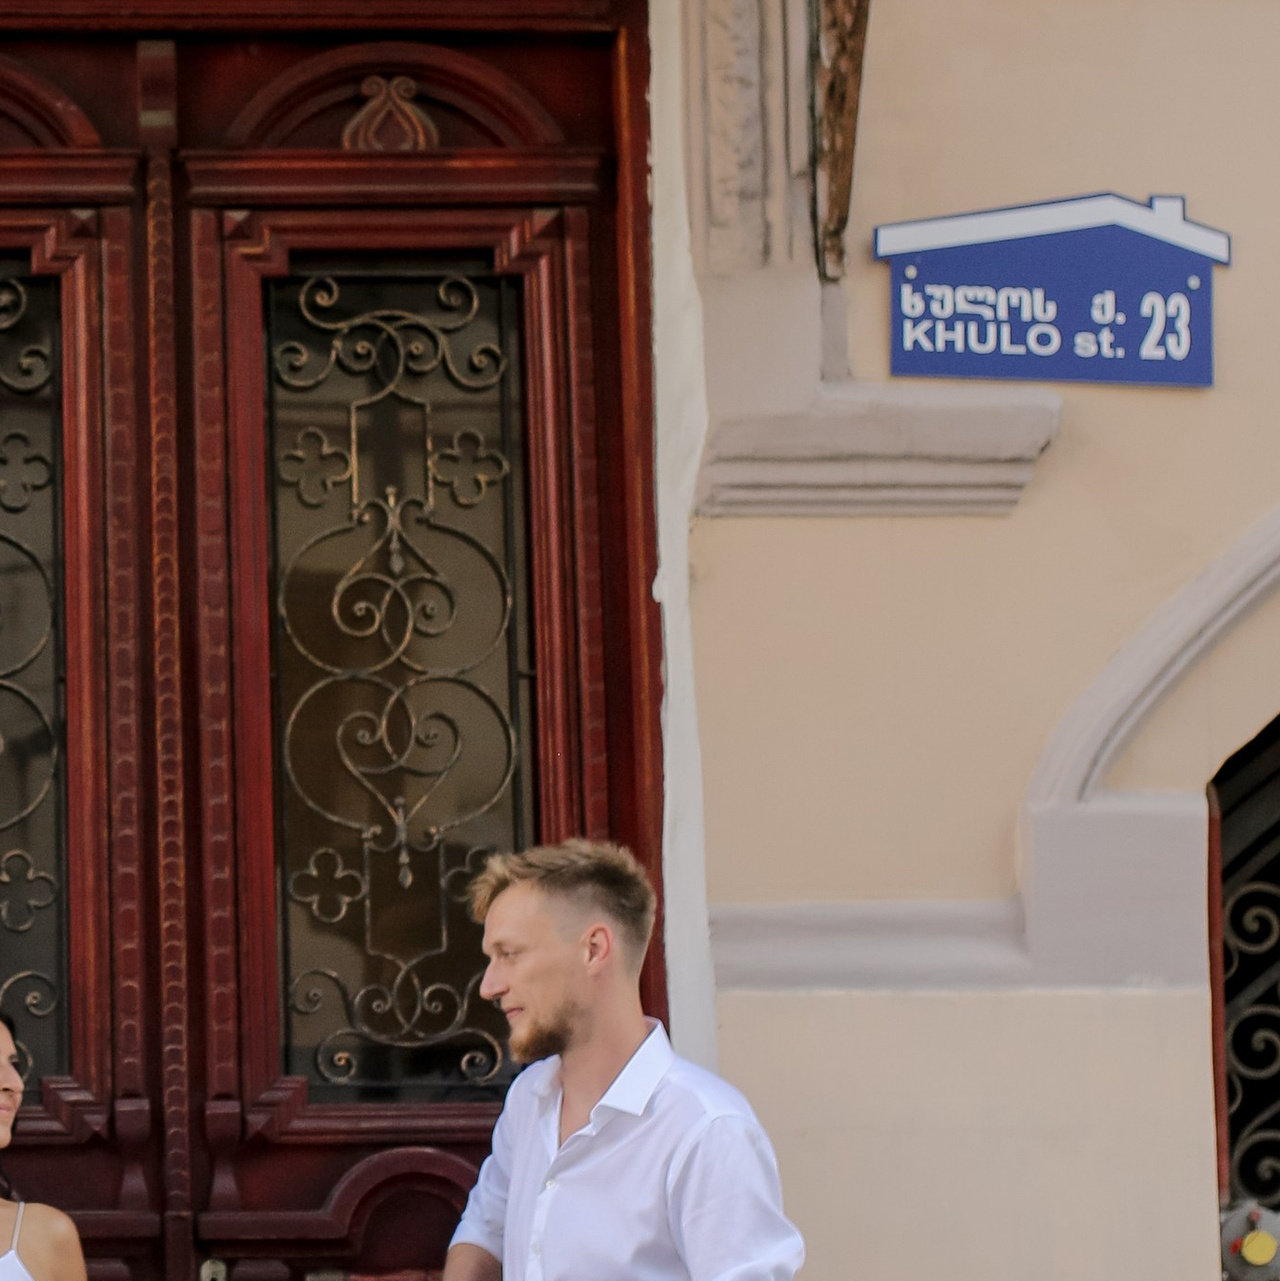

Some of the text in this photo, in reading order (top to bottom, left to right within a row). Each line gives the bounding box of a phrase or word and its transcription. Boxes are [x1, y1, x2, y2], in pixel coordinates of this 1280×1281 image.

[901, 283, 1057, 323] ხულოს
[903, 319, 1125, 358] KHULO st.
[1140, 291, 1191, 361] 23
